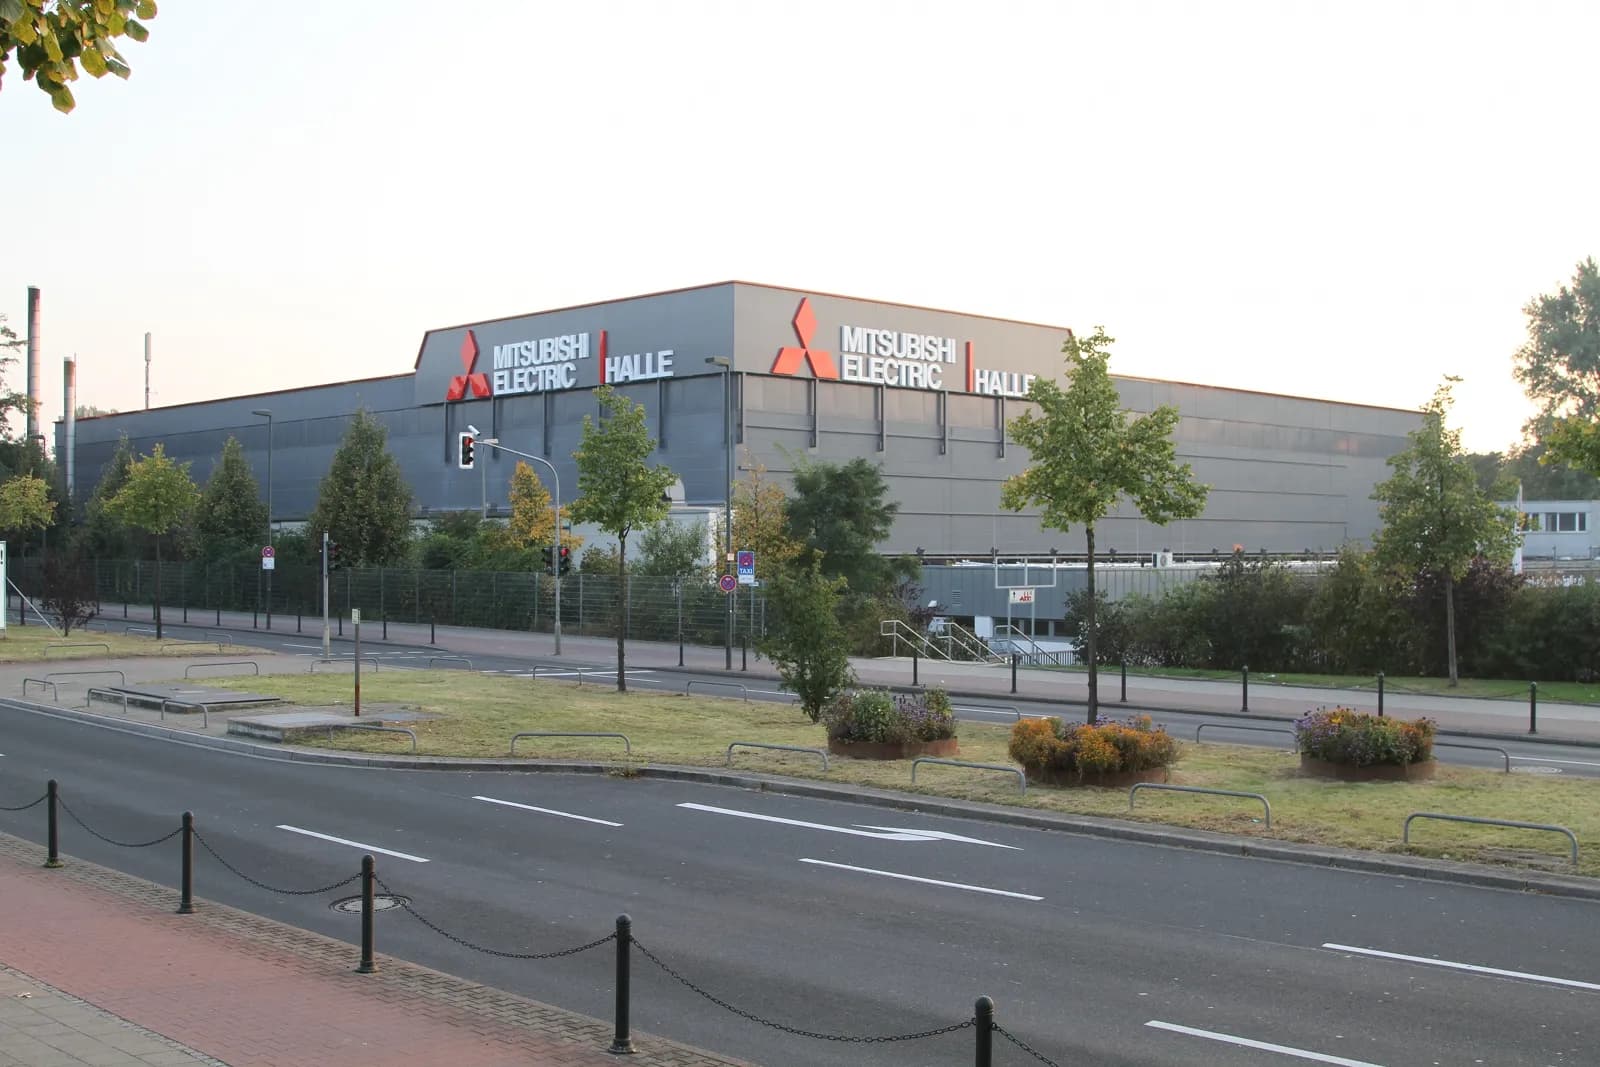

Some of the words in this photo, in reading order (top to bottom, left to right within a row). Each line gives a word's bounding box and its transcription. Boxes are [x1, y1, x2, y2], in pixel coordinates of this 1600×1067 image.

[493, 332, 590, 370] MITSUBISHI
[840, 325, 956, 363] MITSUBISHI
[493, 362, 577, 396] ELECTRIC
[605, 349, 674, 384] HALLE
[840, 355, 943, 389] ELECTRIC
